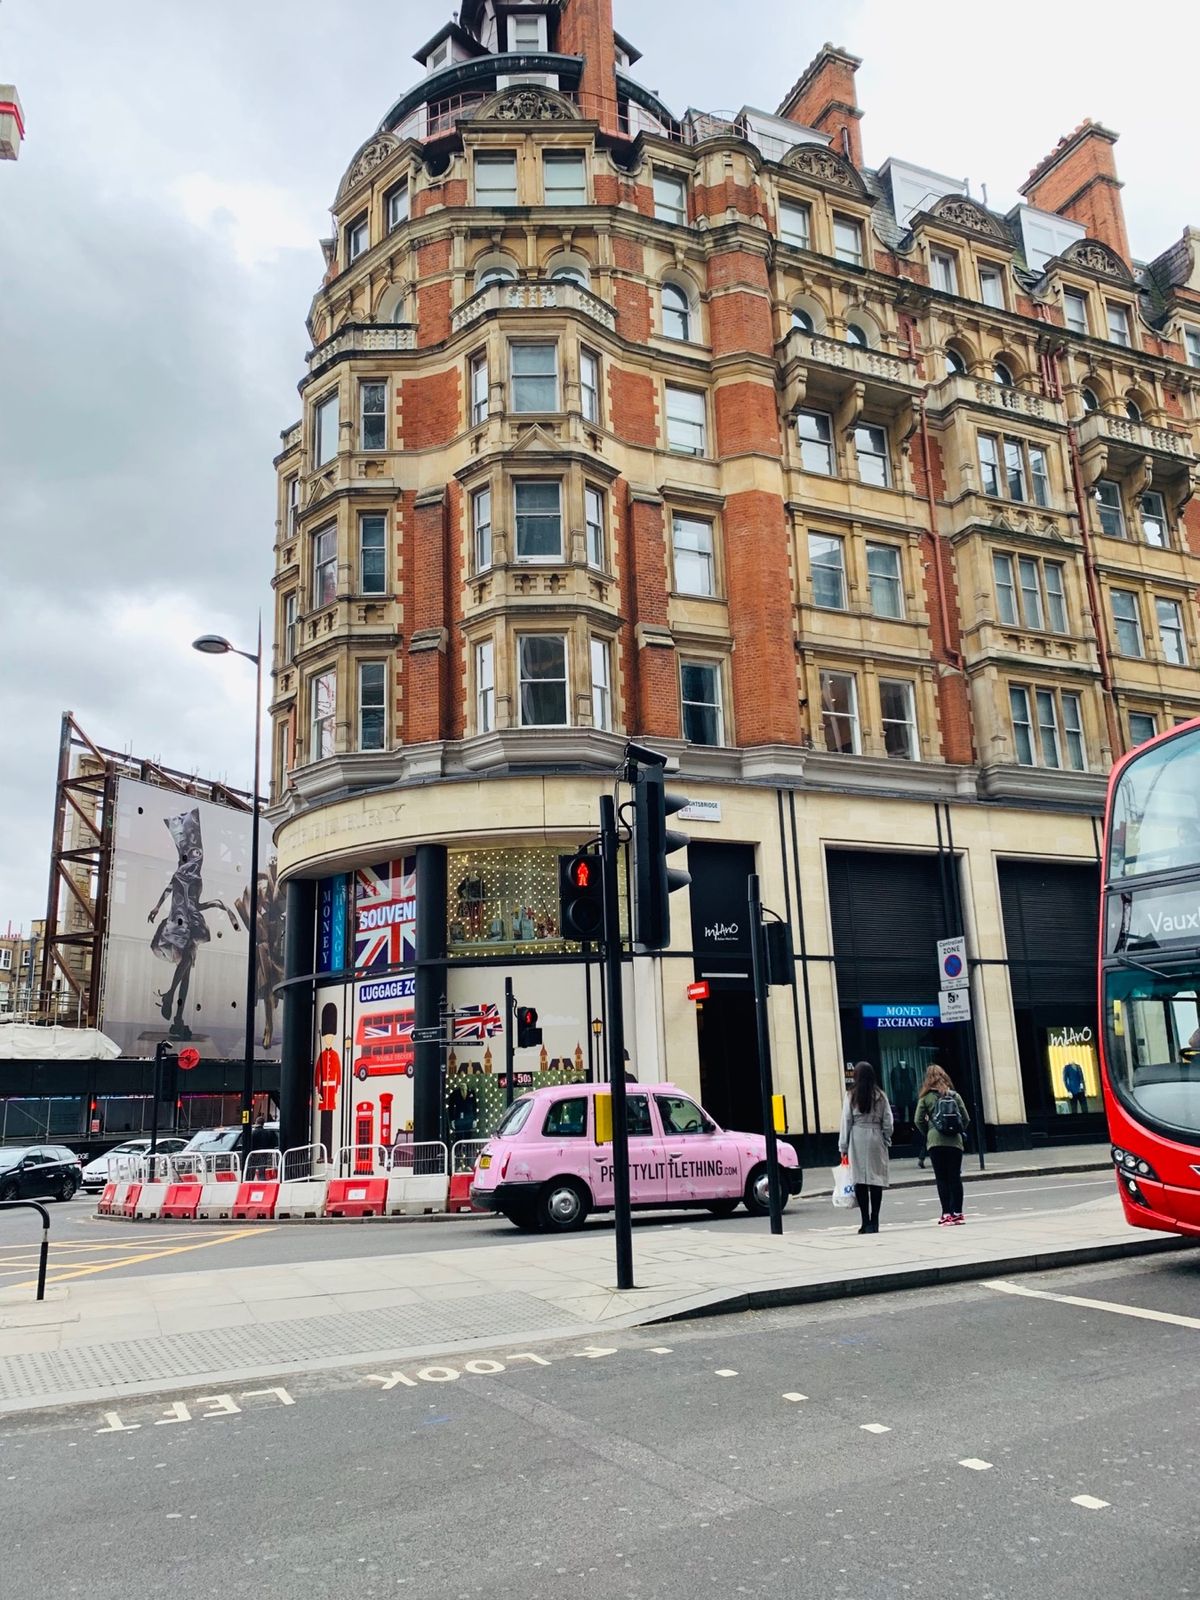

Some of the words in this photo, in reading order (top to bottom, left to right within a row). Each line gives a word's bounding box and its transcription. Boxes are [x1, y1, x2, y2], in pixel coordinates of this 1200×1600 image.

[322, 890, 331, 964] MONEY
[361, 982, 403, 1001] LUGGAGE
[886, 1006, 923, 1016] MONEY
[877, 1017, 934, 1028] EXCHANGE
[600, 1160, 738, 1182] PRTYLITTLETHING.COM
[366, 1352, 552, 1390] LOOK
[95, 1386, 296, 1434] LEFT
